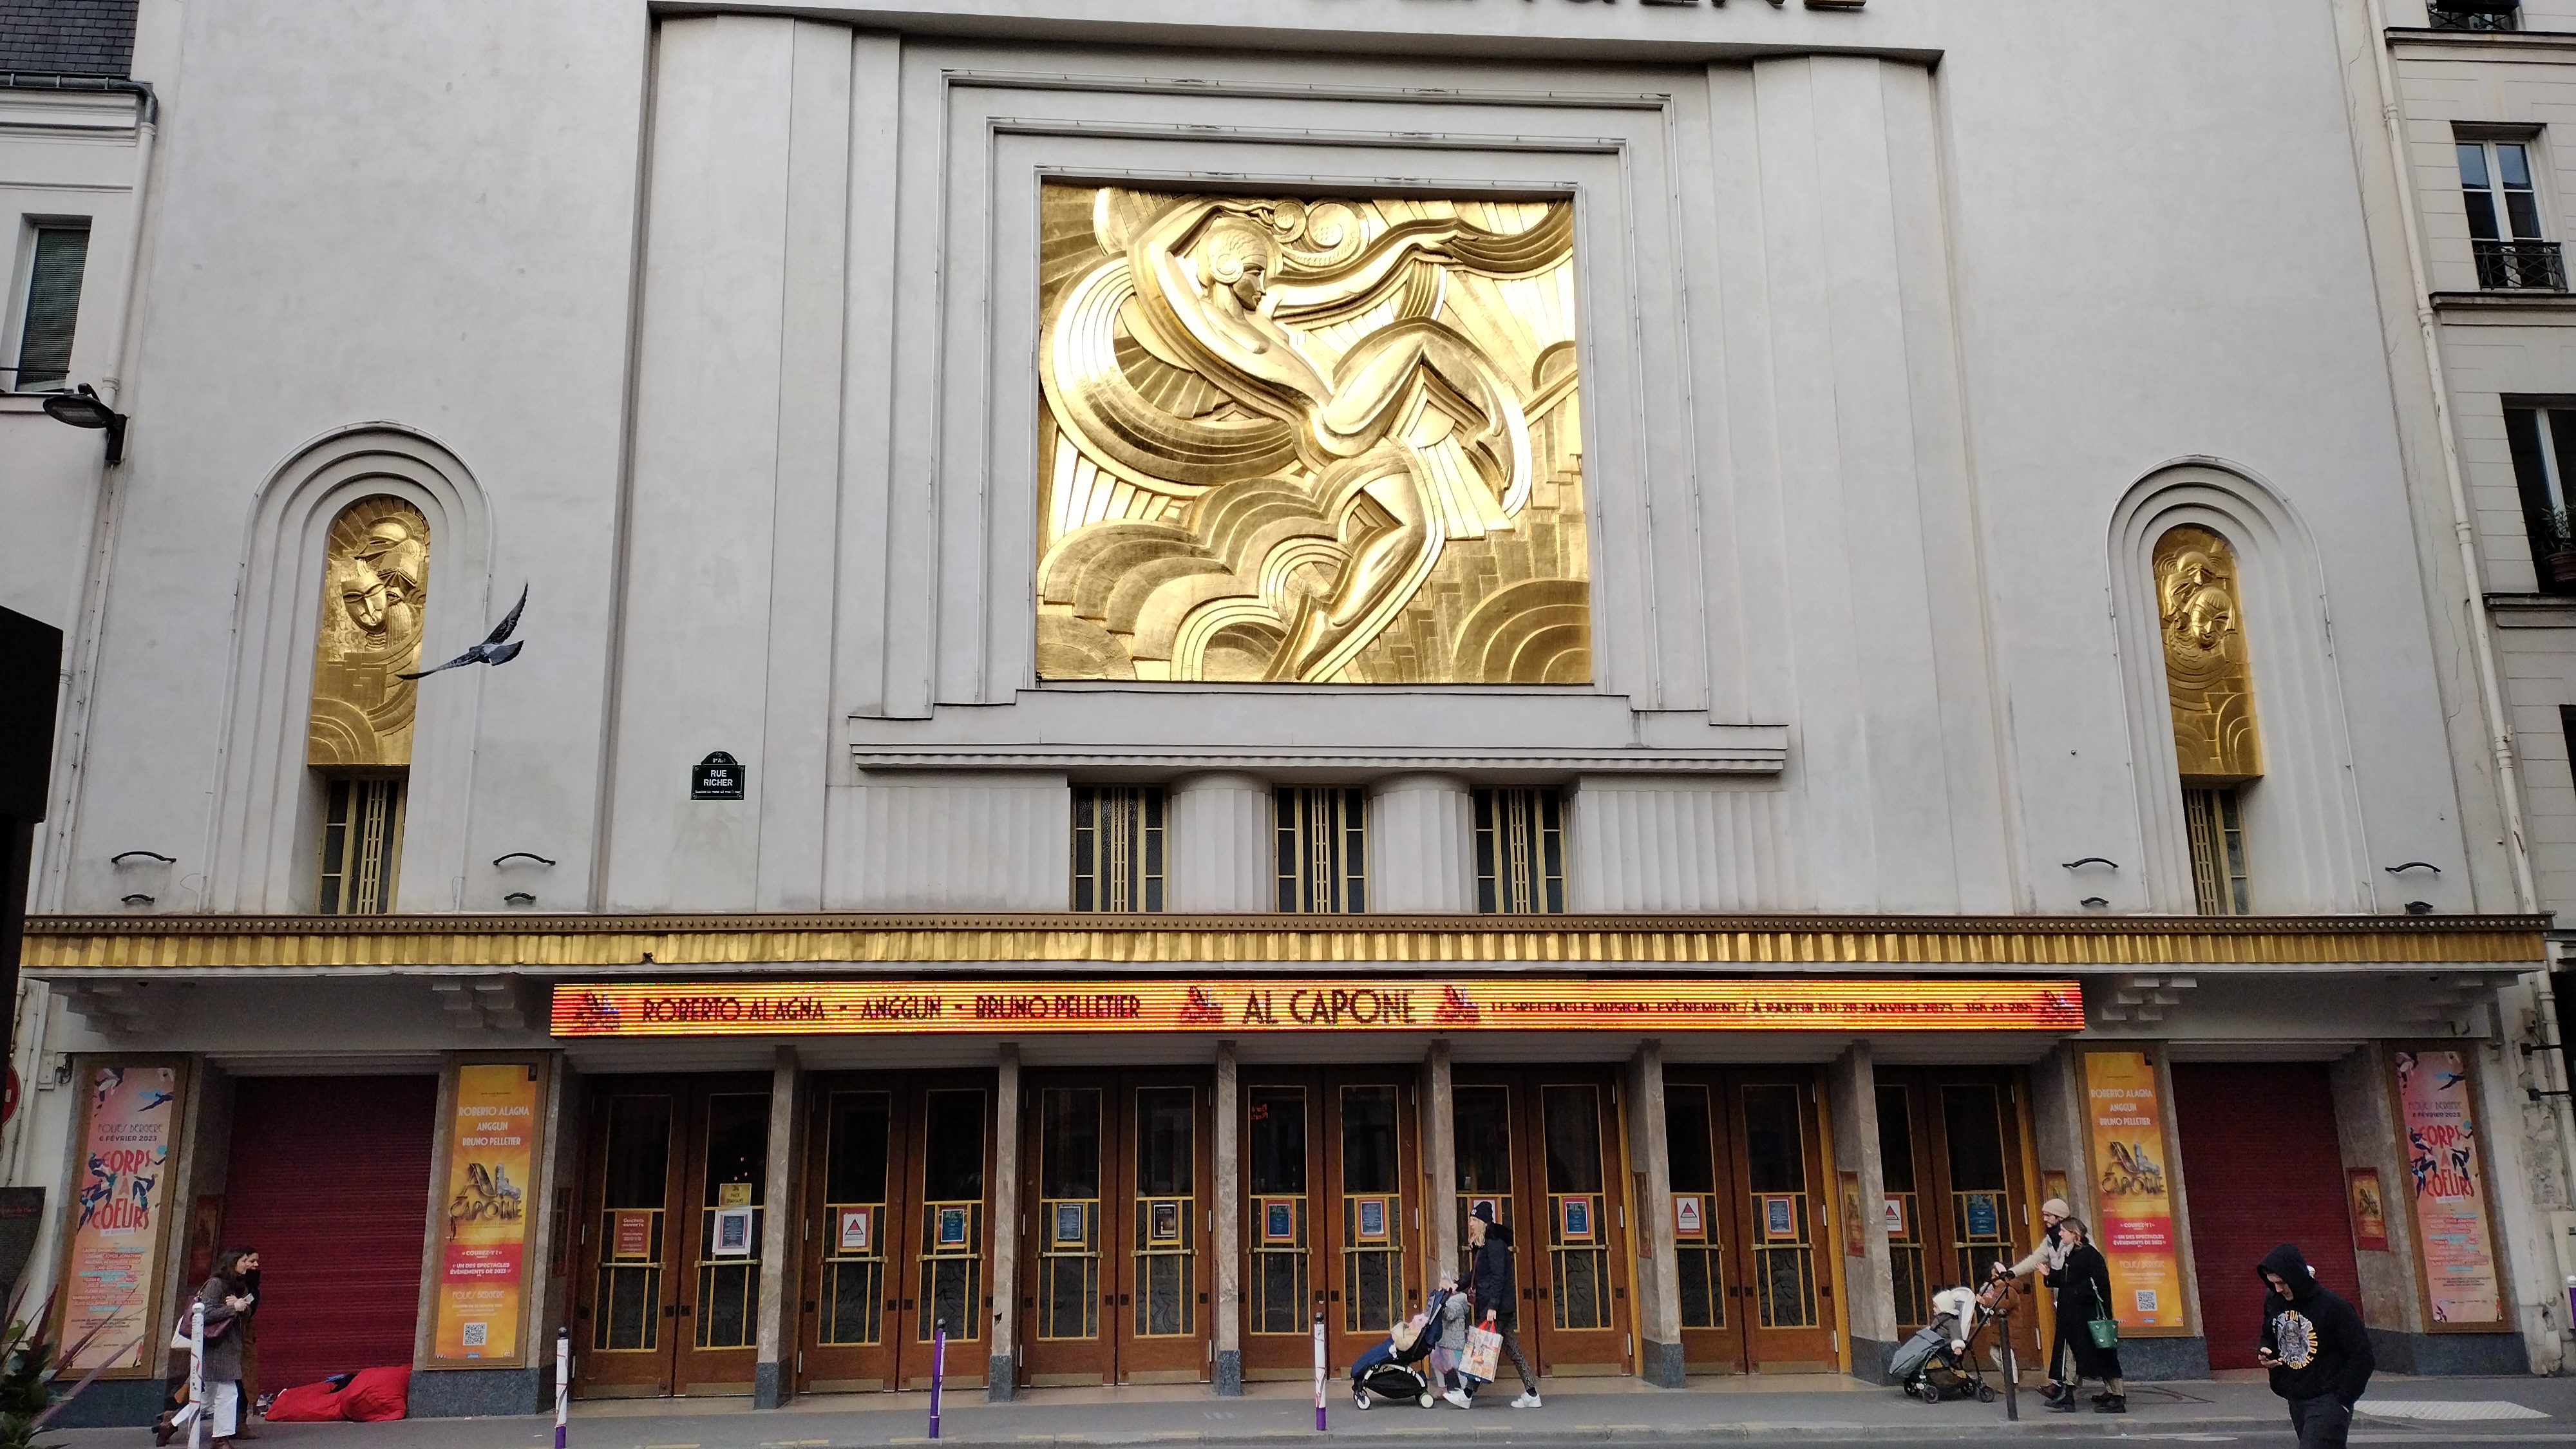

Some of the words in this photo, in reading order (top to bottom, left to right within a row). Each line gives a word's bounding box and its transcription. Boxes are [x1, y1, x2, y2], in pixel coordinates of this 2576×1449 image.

[643, 997, 740, 1022] ROBERTO
[748, 997, 824, 1022] ALAGNA
[862, 996, 941, 1019] ANGGUN
[976, 995, 1046, 1018] BRUNO
[1055, 994, 1140, 1018] PELLETIER
[1242, 989, 1279, 1025] AL
[1289, 989, 1416, 1025] CAPONE
[2090, 1089, 2124, 1098] ROBERTO
[2126, 1089, 2153, 1097] ALAGNA
[459, 1107, 497, 1116] ROBERTO
[498, 1106, 529, 1115] ALAGNA
[2110, 1103, 2137, 1112] ANGGUN
[477, 1122, 507, 1131] ANGGUN
[2099, 1117, 2122, 1126] BRUNO
[462, 1137, 488, 1146] BRUNO
[489, 1137, 521, 1146] PELLETIER
[2420, 1125, 2461, 1149] CORPS
[102, 1150, 151, 1176] CORPS
[2101, 1175, 2166, 1194] CAPONE
[2426, 1169, 2474, 1198] COEURS
[91, 1198, 149, 1231] COEURS
[450, 1198, 522, 1220] CAPONE
